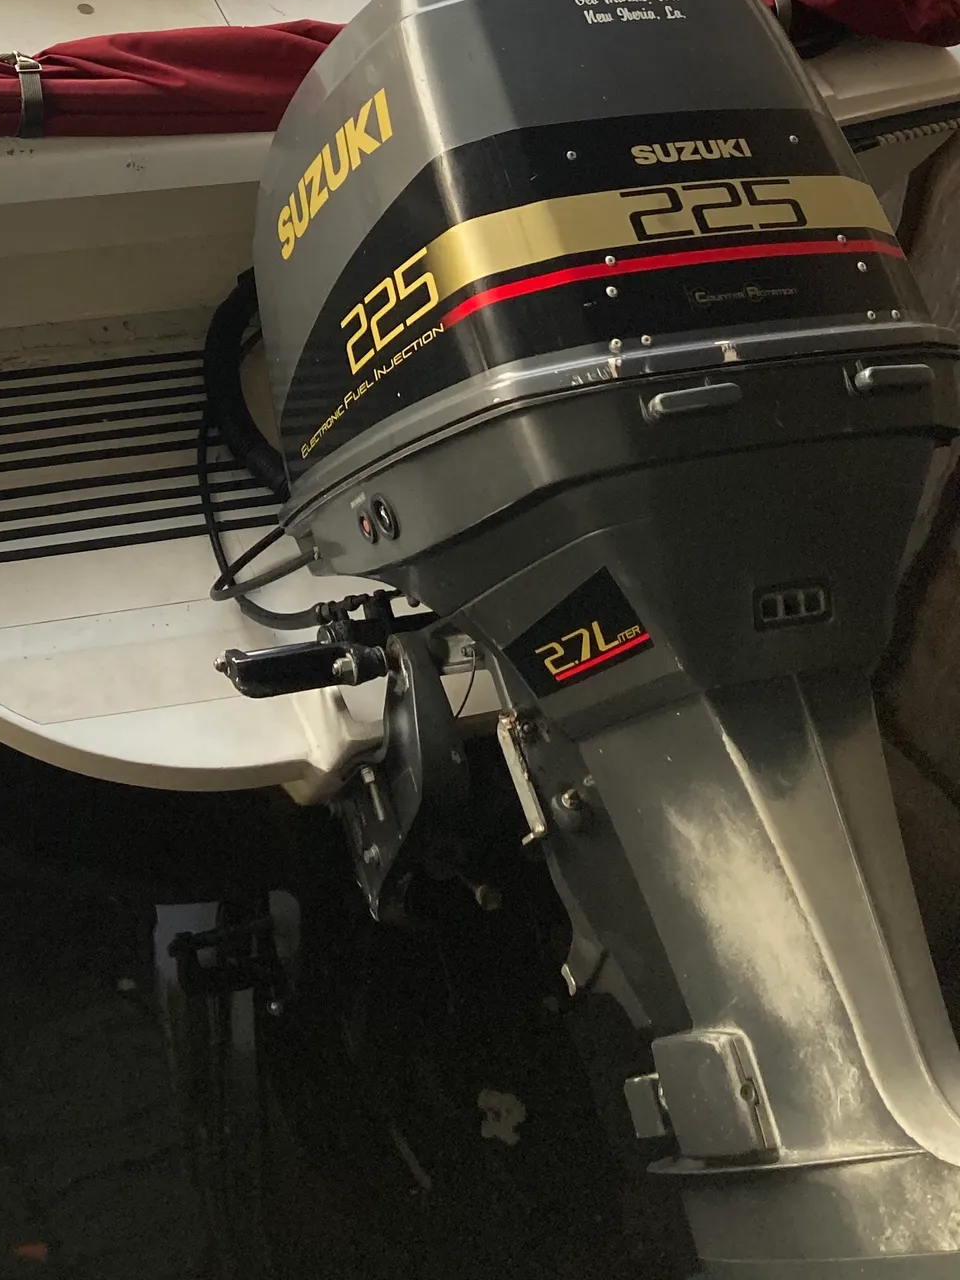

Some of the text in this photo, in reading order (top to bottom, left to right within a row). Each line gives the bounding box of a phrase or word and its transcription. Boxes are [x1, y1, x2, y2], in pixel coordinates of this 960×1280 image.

[583, 9, 615, 24] New
[278, 87, 393, 260] SUZUKI
[630, 138, 752, 165] SUZUKI
[619, 178, 808, 242] 225
[340, 246, 439, 375] 225
[300, 322, 445, 459] ELECTRONIC FUEL INJECTION
